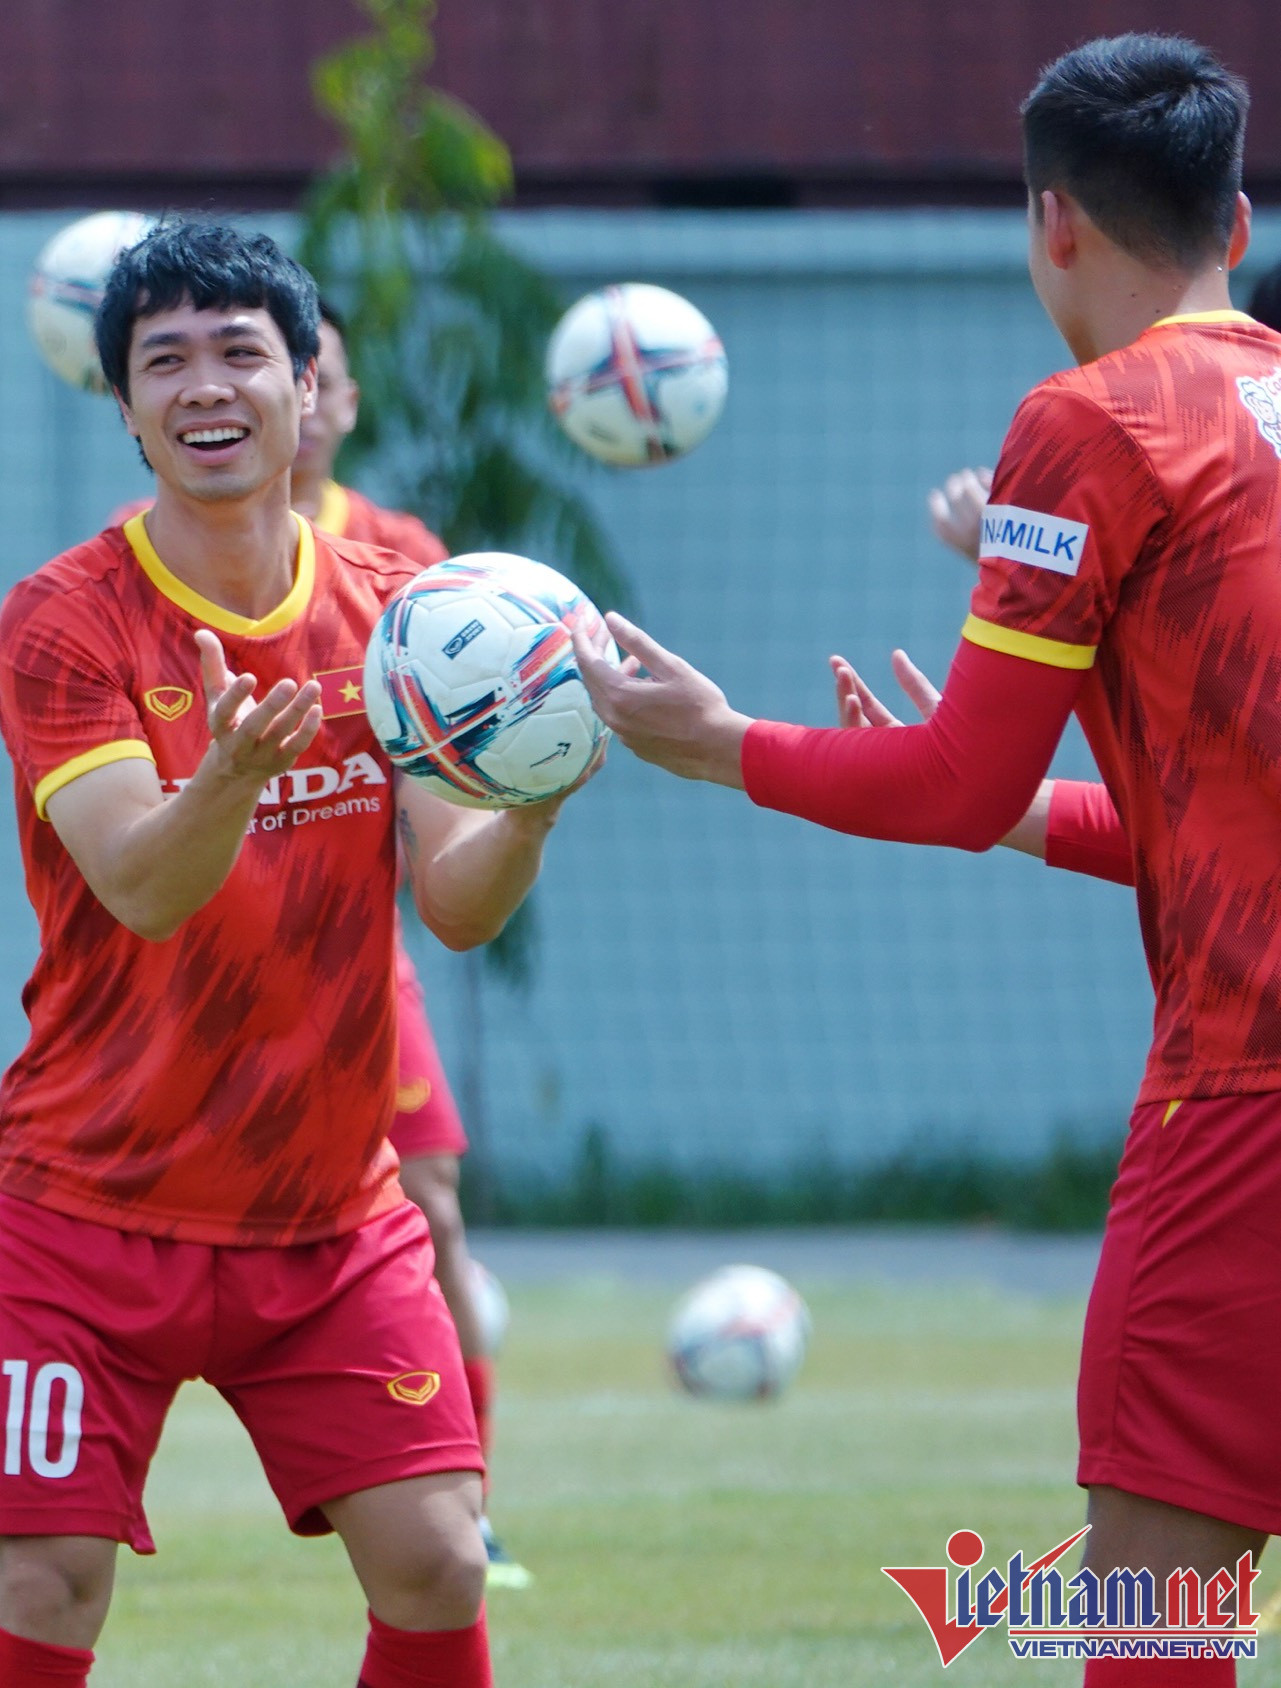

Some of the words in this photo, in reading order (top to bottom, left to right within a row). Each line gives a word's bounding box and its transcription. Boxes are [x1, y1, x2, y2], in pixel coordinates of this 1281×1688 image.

[261, 810, 286, 832] of
[292, 797, 381, 826] Dreams
[2, 1359, 85, 1479] 10
